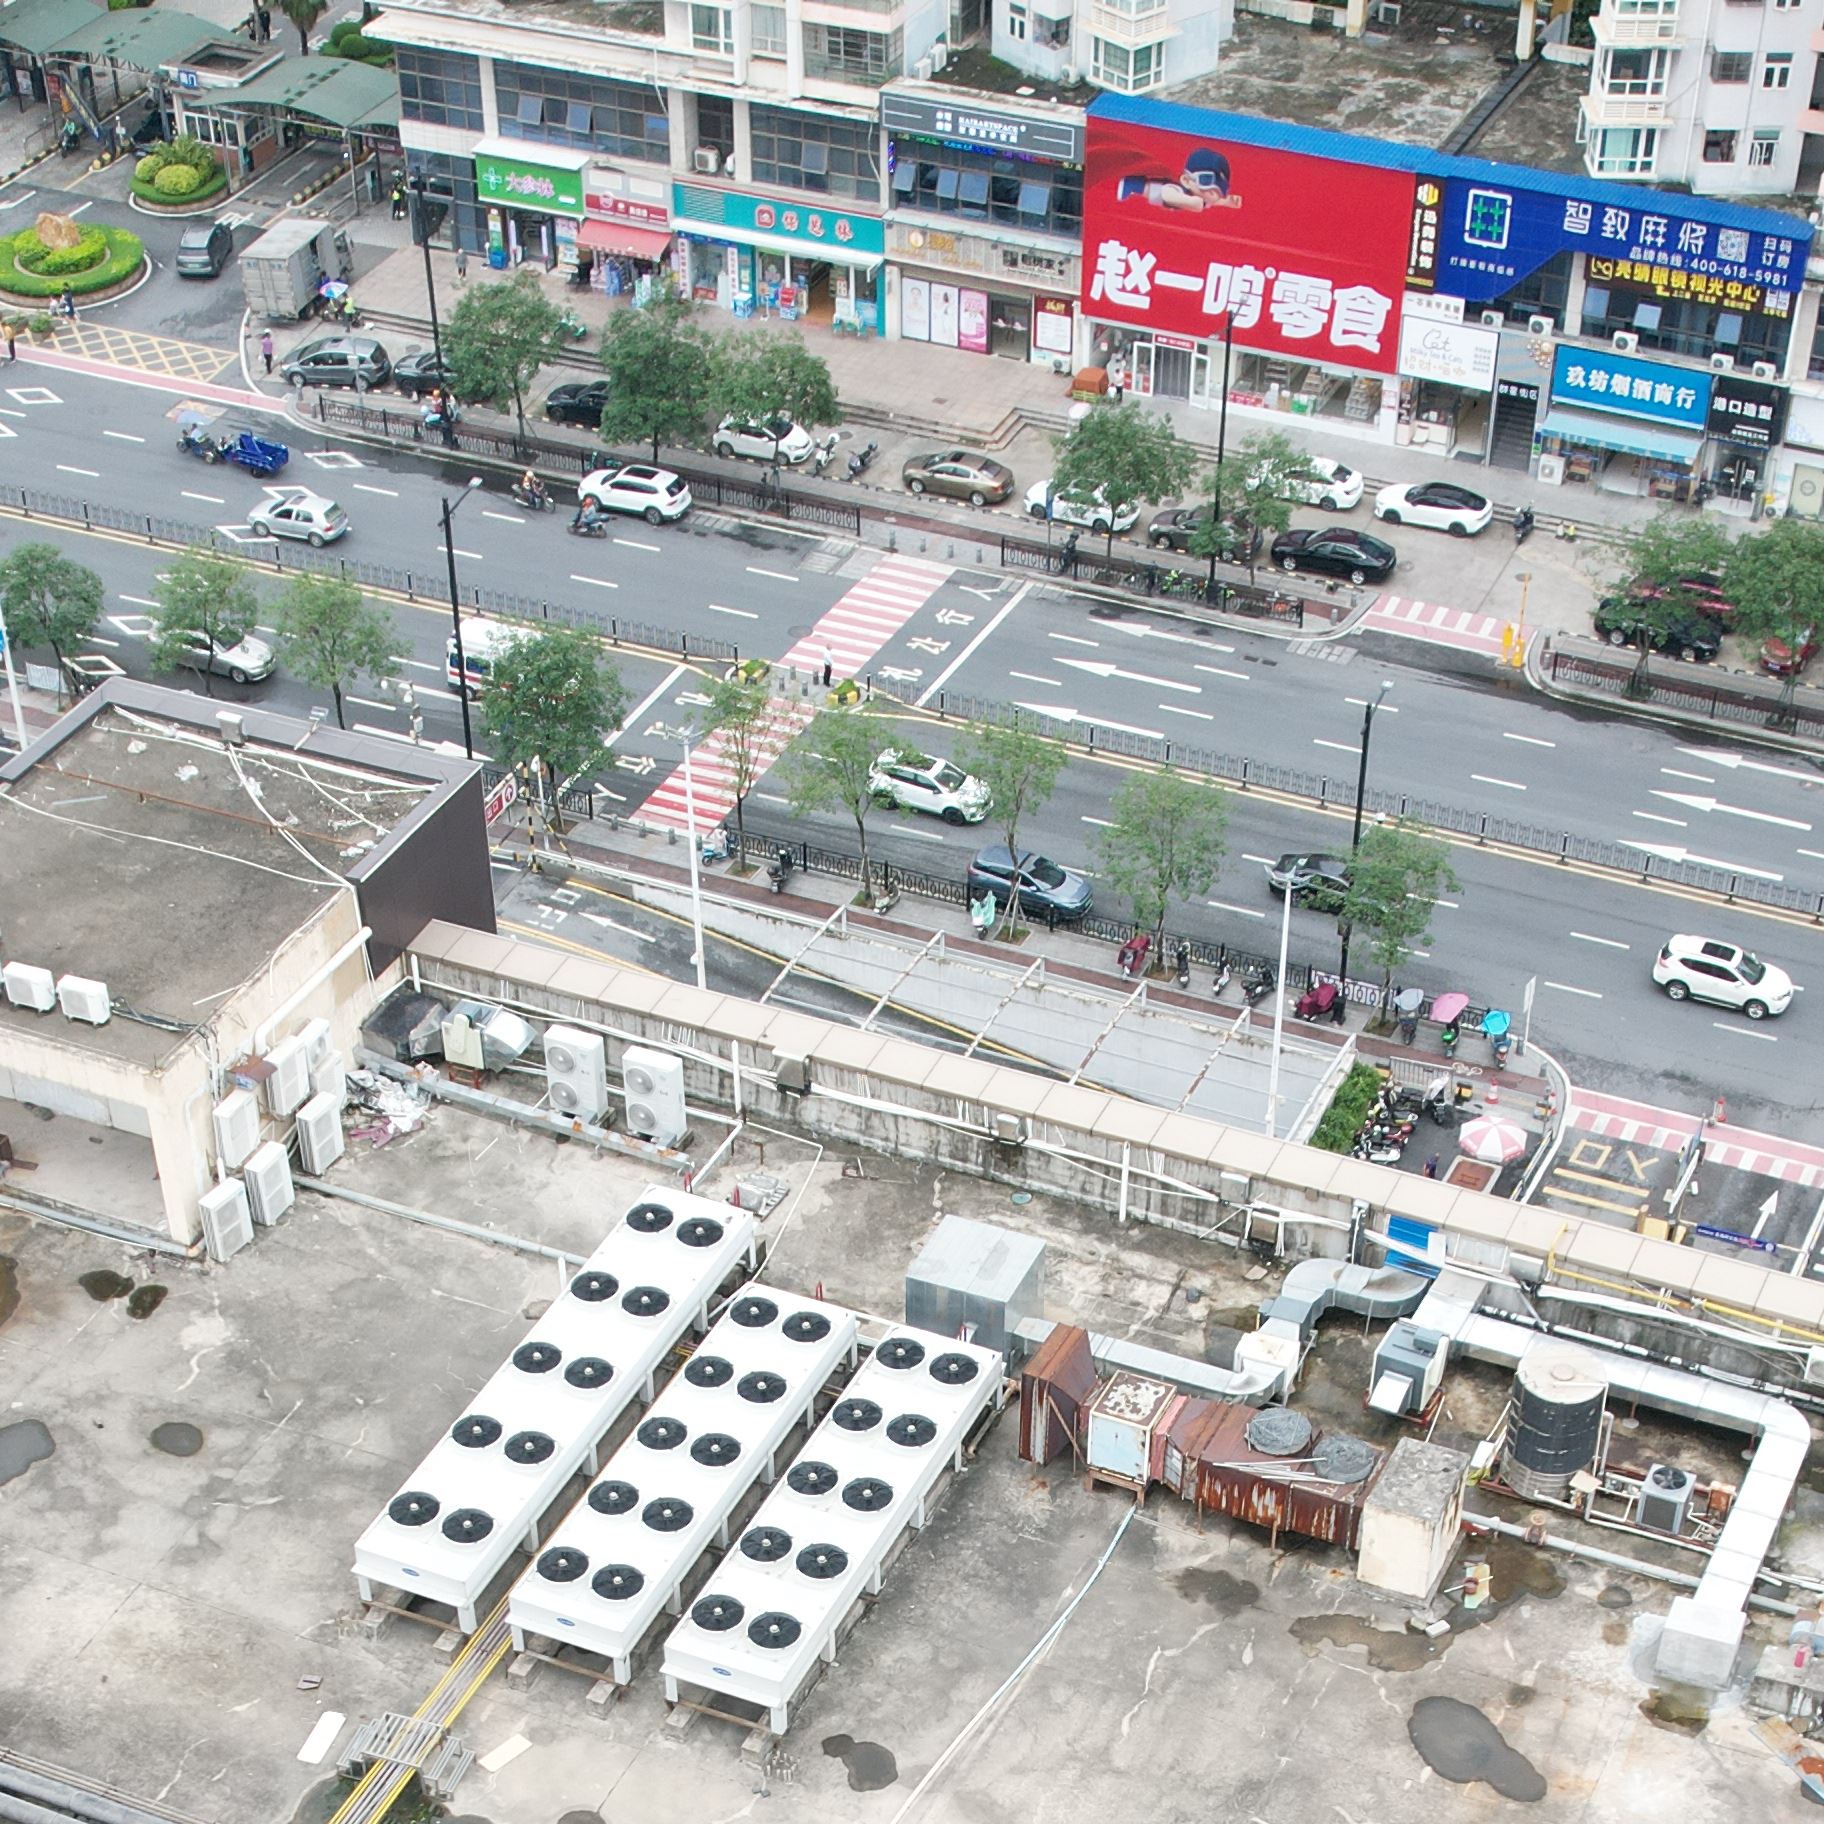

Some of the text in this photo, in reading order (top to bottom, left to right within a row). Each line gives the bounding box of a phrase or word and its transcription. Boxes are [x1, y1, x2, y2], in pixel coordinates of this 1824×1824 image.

[1566, 365, 1697, 410] 玖坊烟酒商行
[877, 583, 1002, 683] 礼让行人
